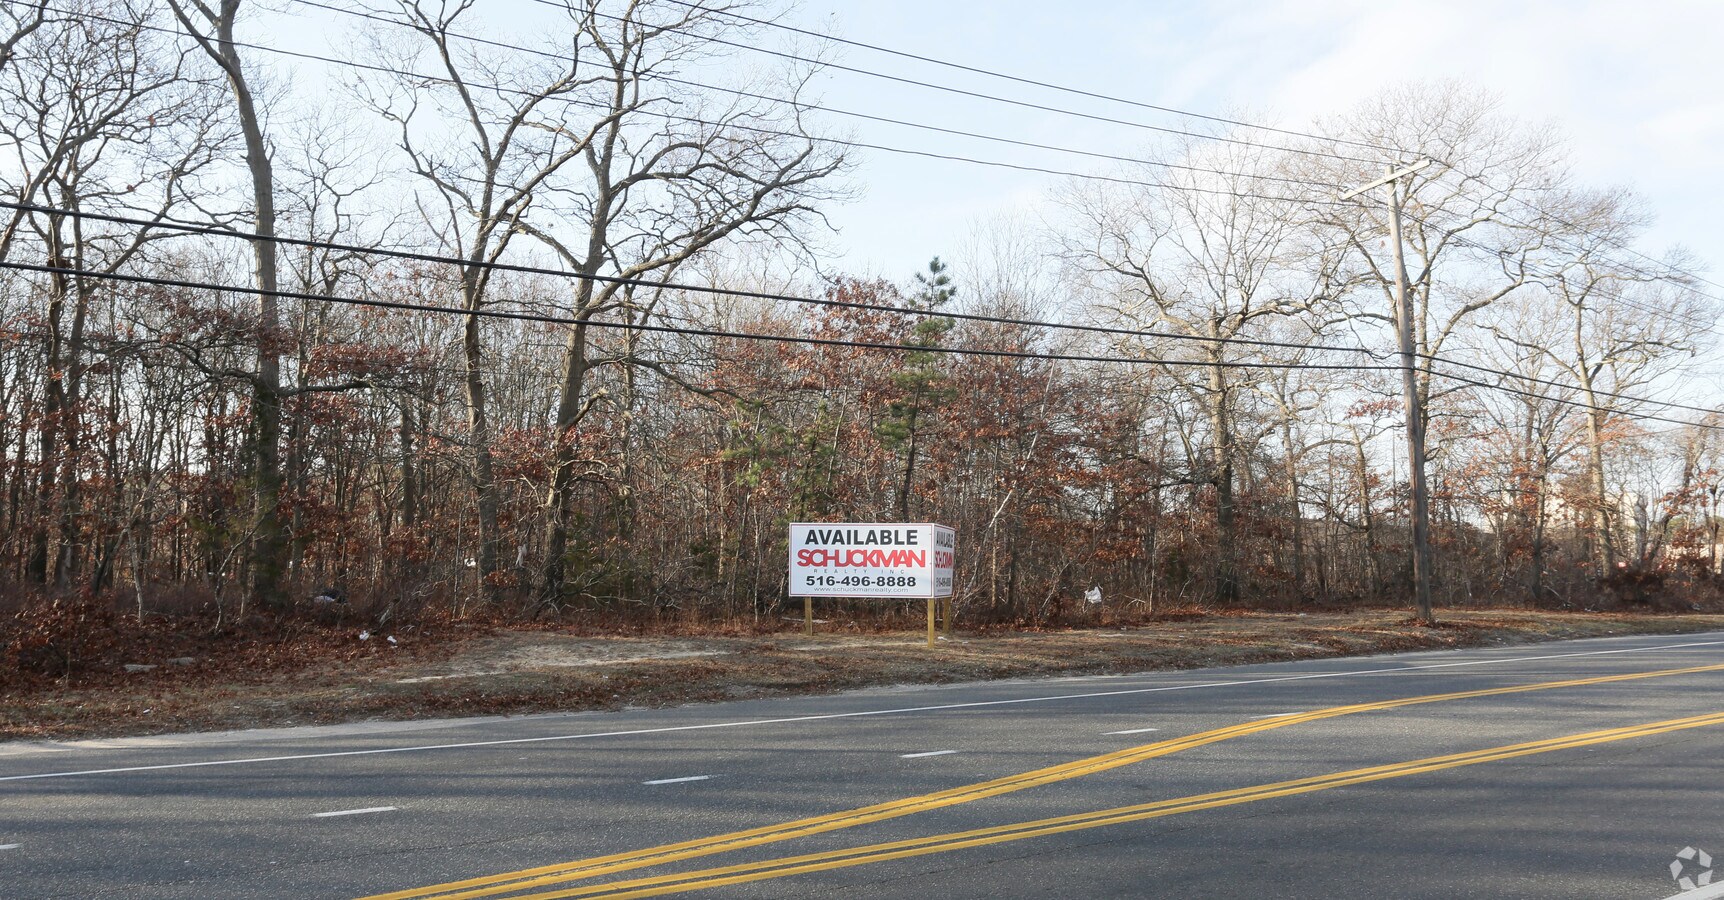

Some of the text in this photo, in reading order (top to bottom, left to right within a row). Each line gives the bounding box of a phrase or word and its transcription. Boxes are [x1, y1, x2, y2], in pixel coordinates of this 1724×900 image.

[805, 529, 918, 545] AVAILABLE
[797, 549, 926, 568] SCHUCKMAN
[806, 575, 917, 587] 516-496-8888
